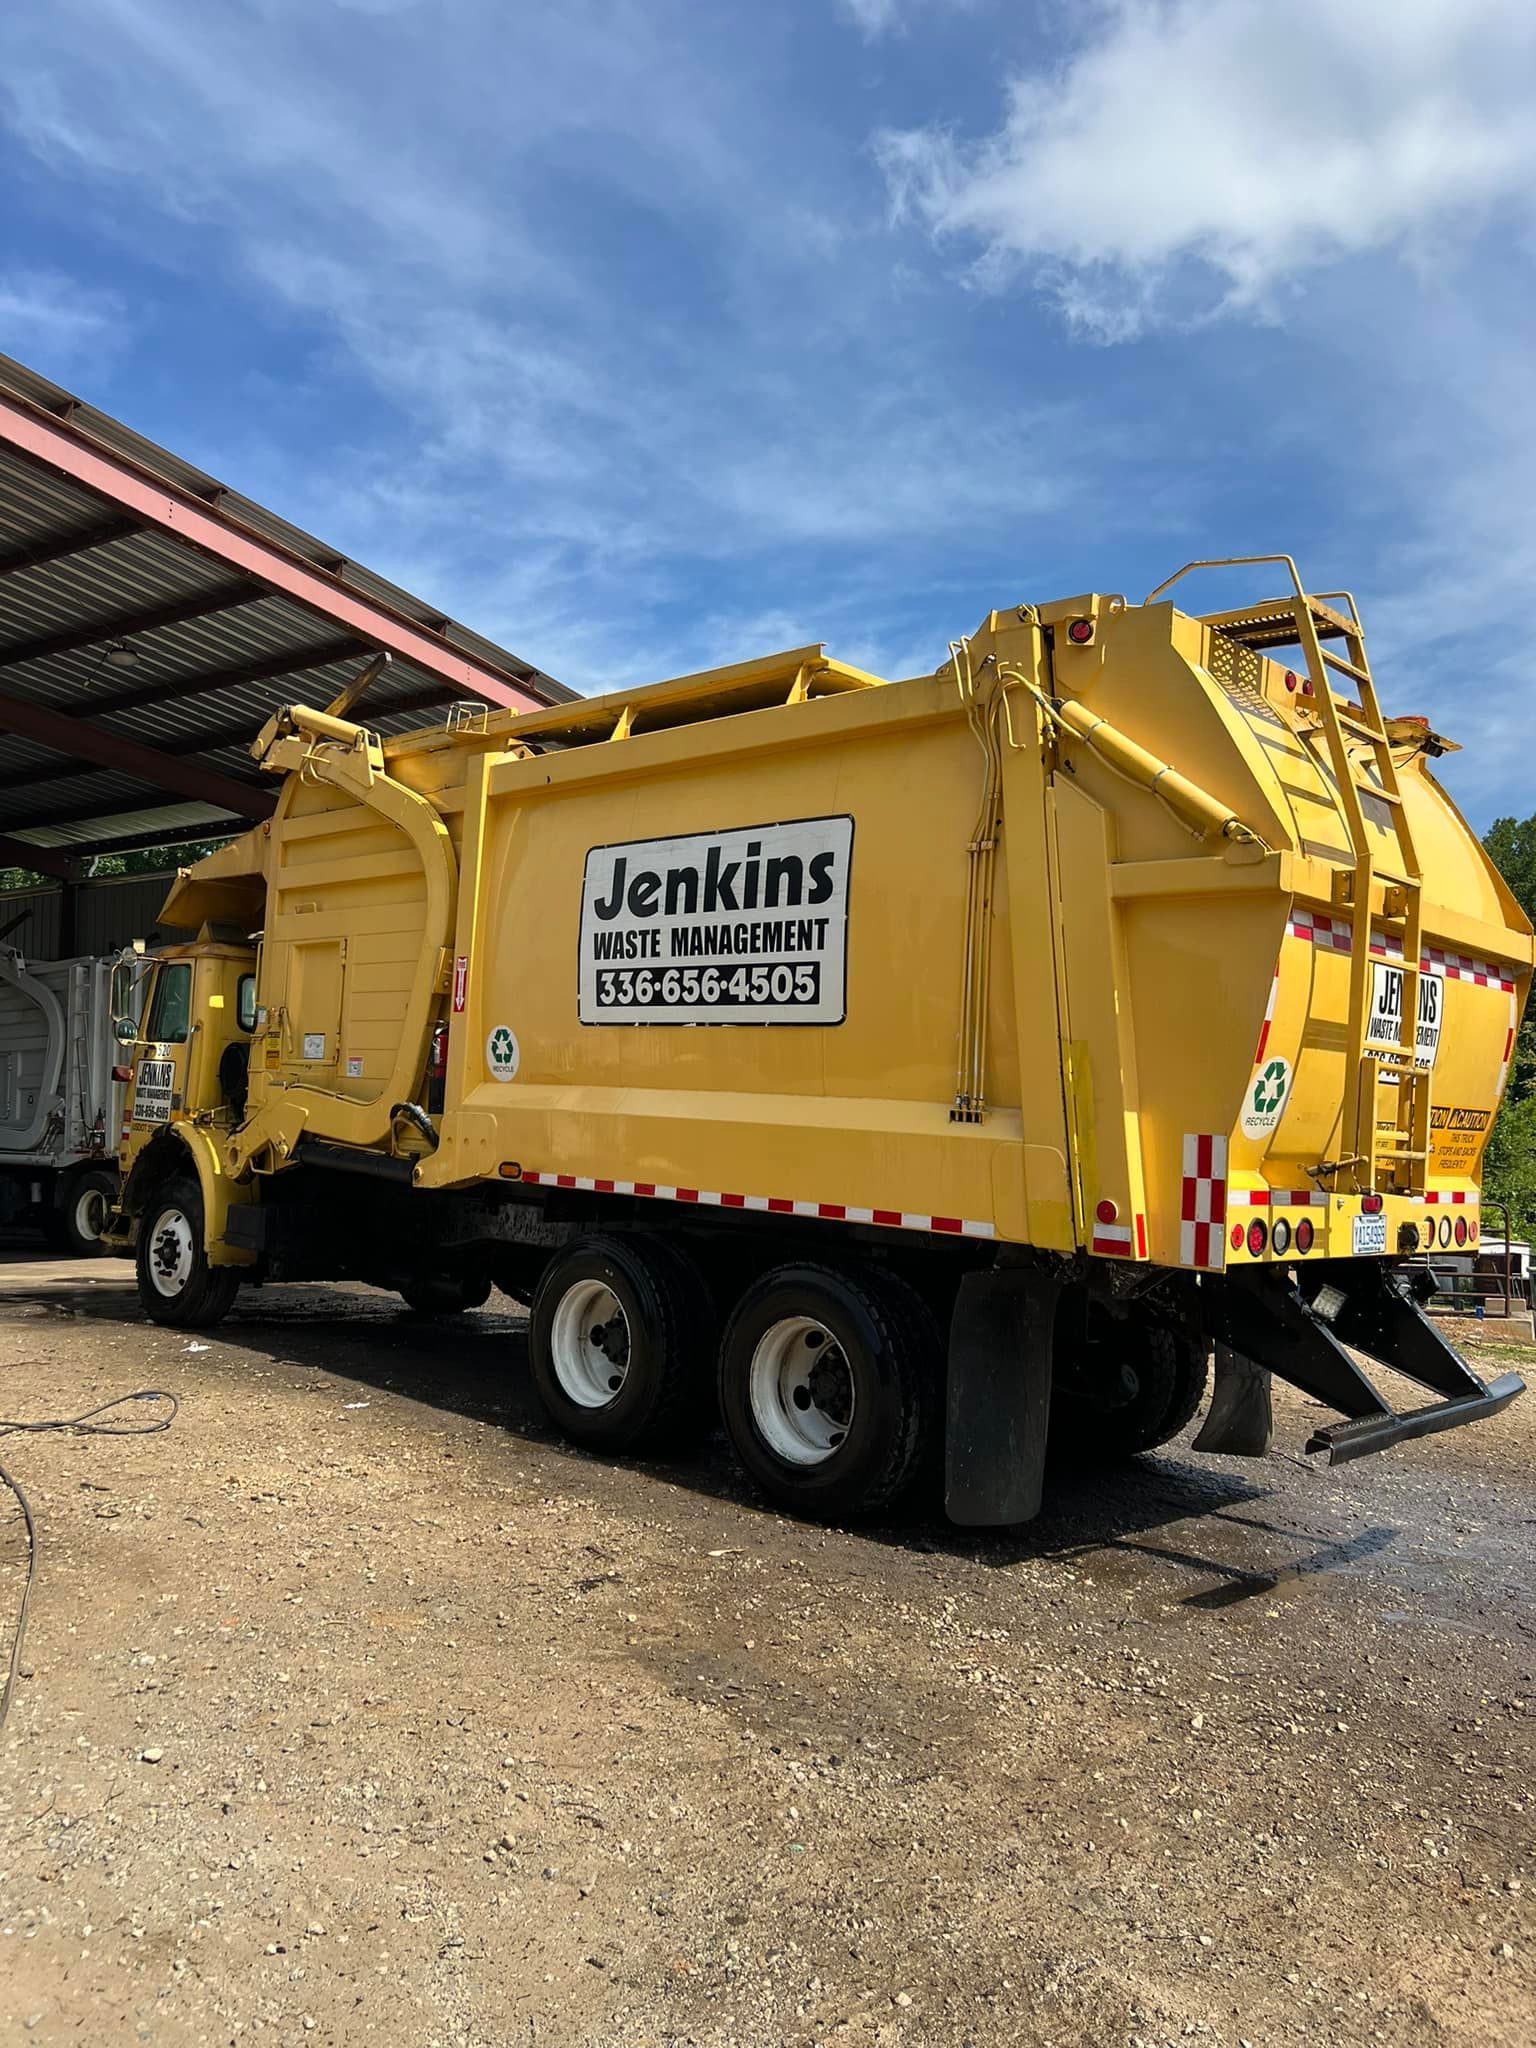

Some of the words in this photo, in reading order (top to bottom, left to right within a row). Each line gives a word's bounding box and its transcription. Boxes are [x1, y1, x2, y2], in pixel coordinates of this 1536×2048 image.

[593, 841, 835, 921] Jenkins
[593, 929, 661, 960] WASTE
[671, 918, 829, 957] MANAGEMENT
[1378, 970, 1438, 1023] JENNS
[1370, 1017, 1393, 1040] WASTE
[139, 1063, 172, 1088] JENKINS
[1245, 1116, 1276, 1127] RECYCLE
[1456, 1110, 1488, 1130] CAUTION
